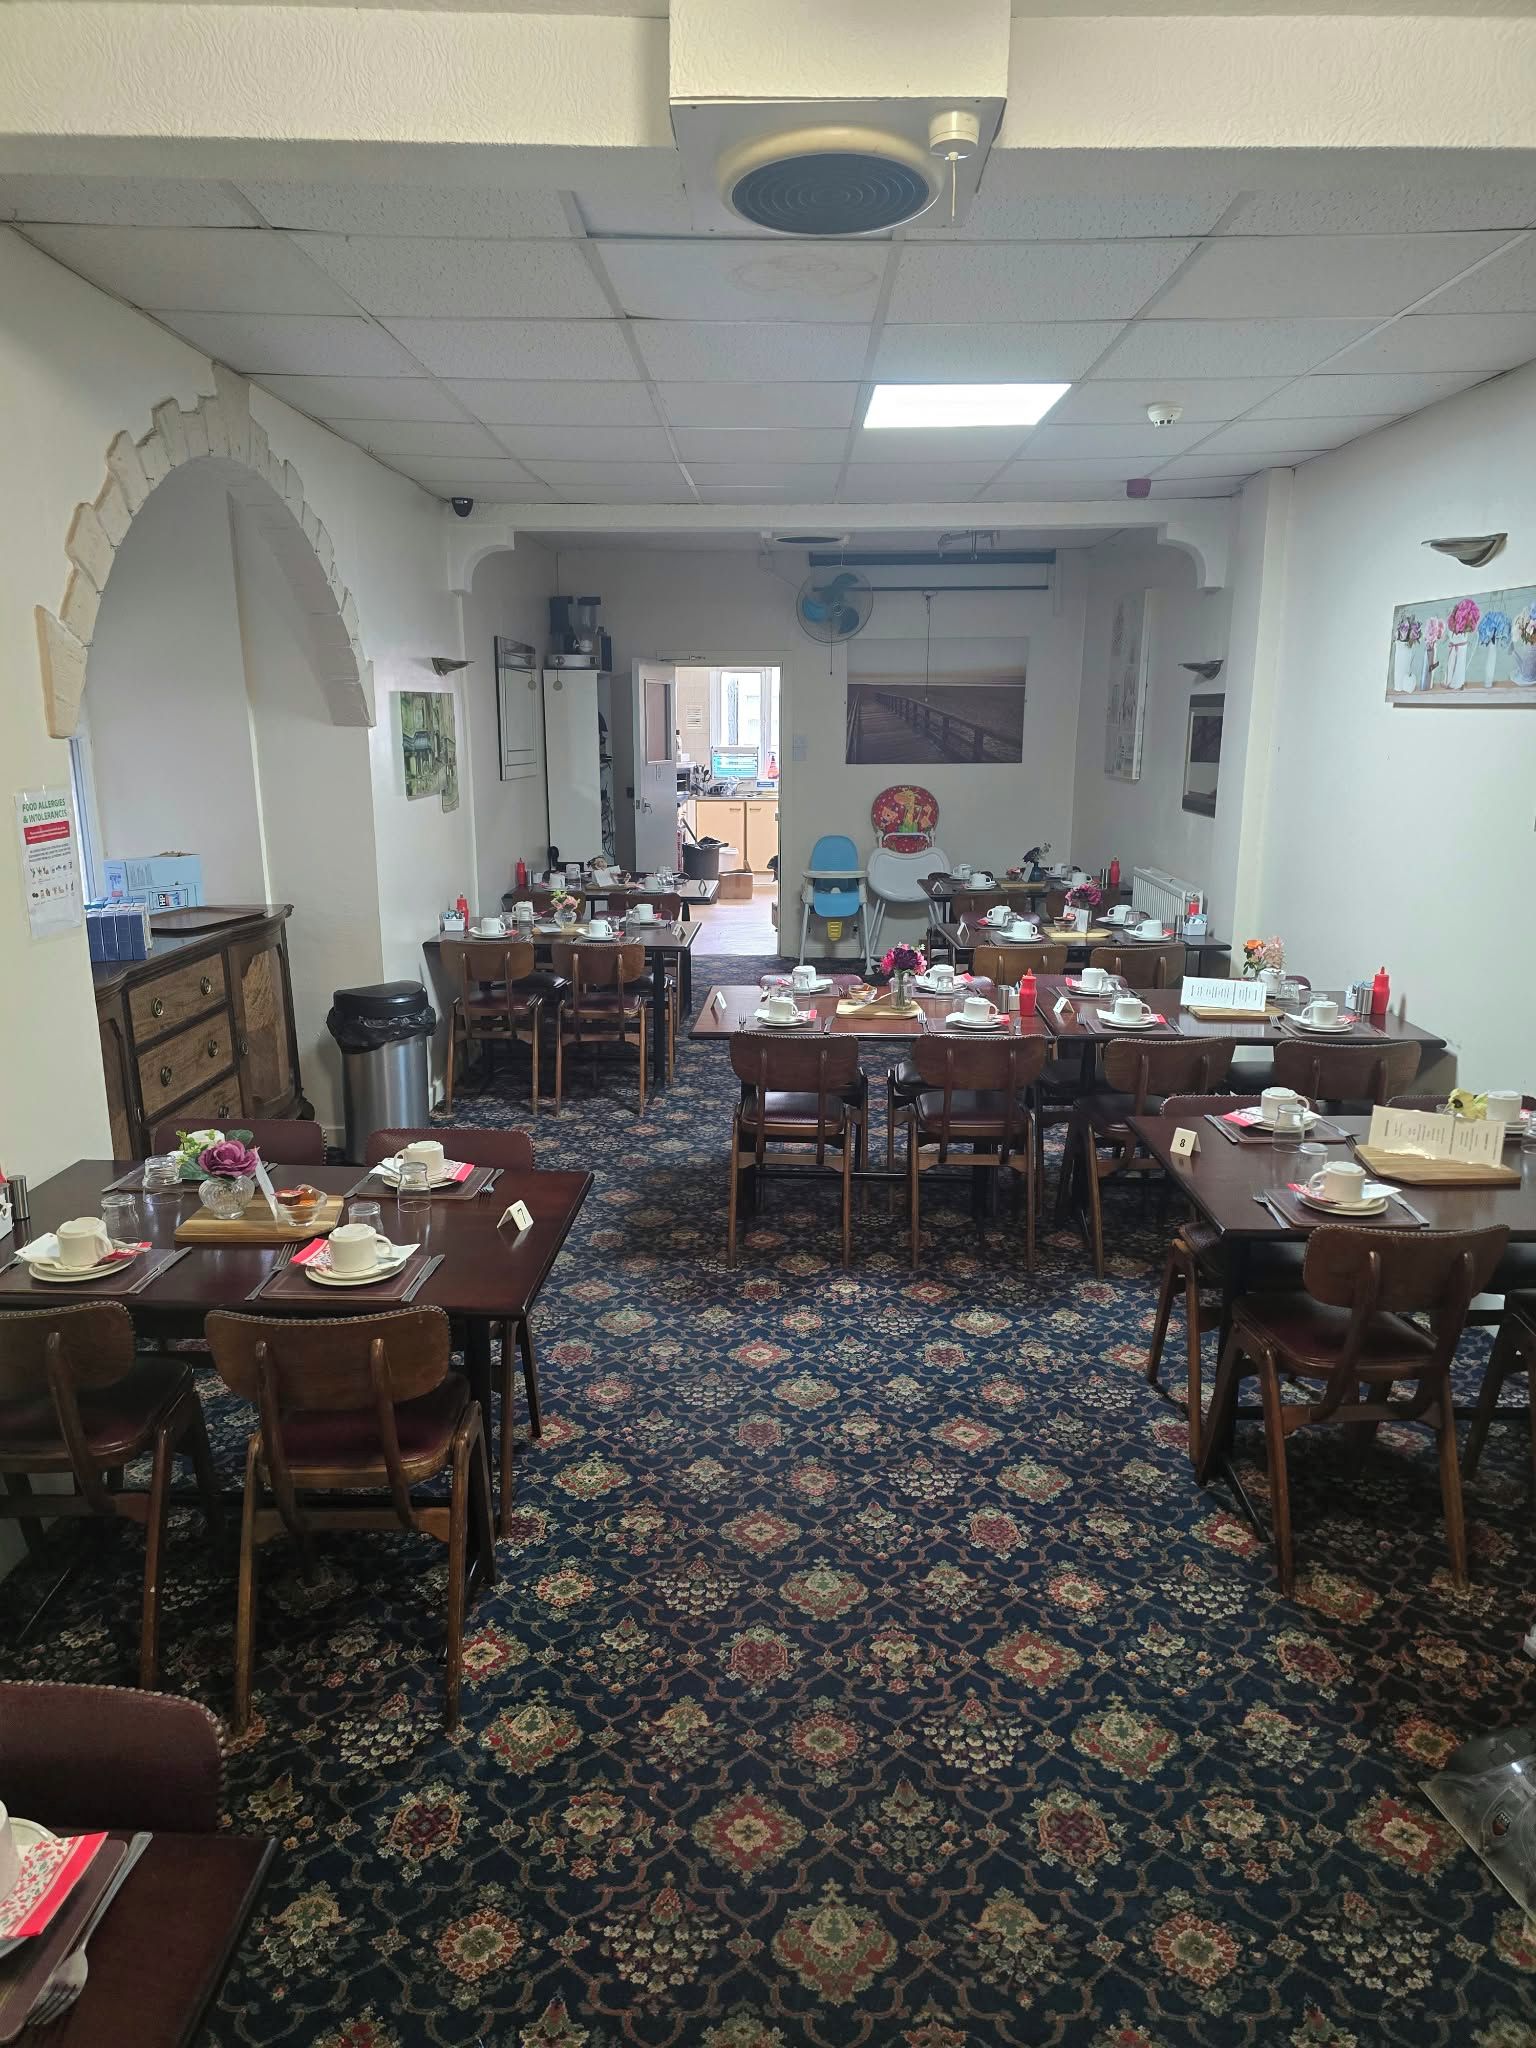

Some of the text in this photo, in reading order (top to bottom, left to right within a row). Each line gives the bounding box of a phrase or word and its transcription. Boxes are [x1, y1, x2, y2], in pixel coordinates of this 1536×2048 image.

[22, 798, 65, 812] FOOD ALLERGIES
[29, 809, 68, 823] INTOLERANCES
[159, 894, 166, 906] HP
[1179, 1138, 1186, 1148] 8
[517, 1207, 526, 1224] 7
